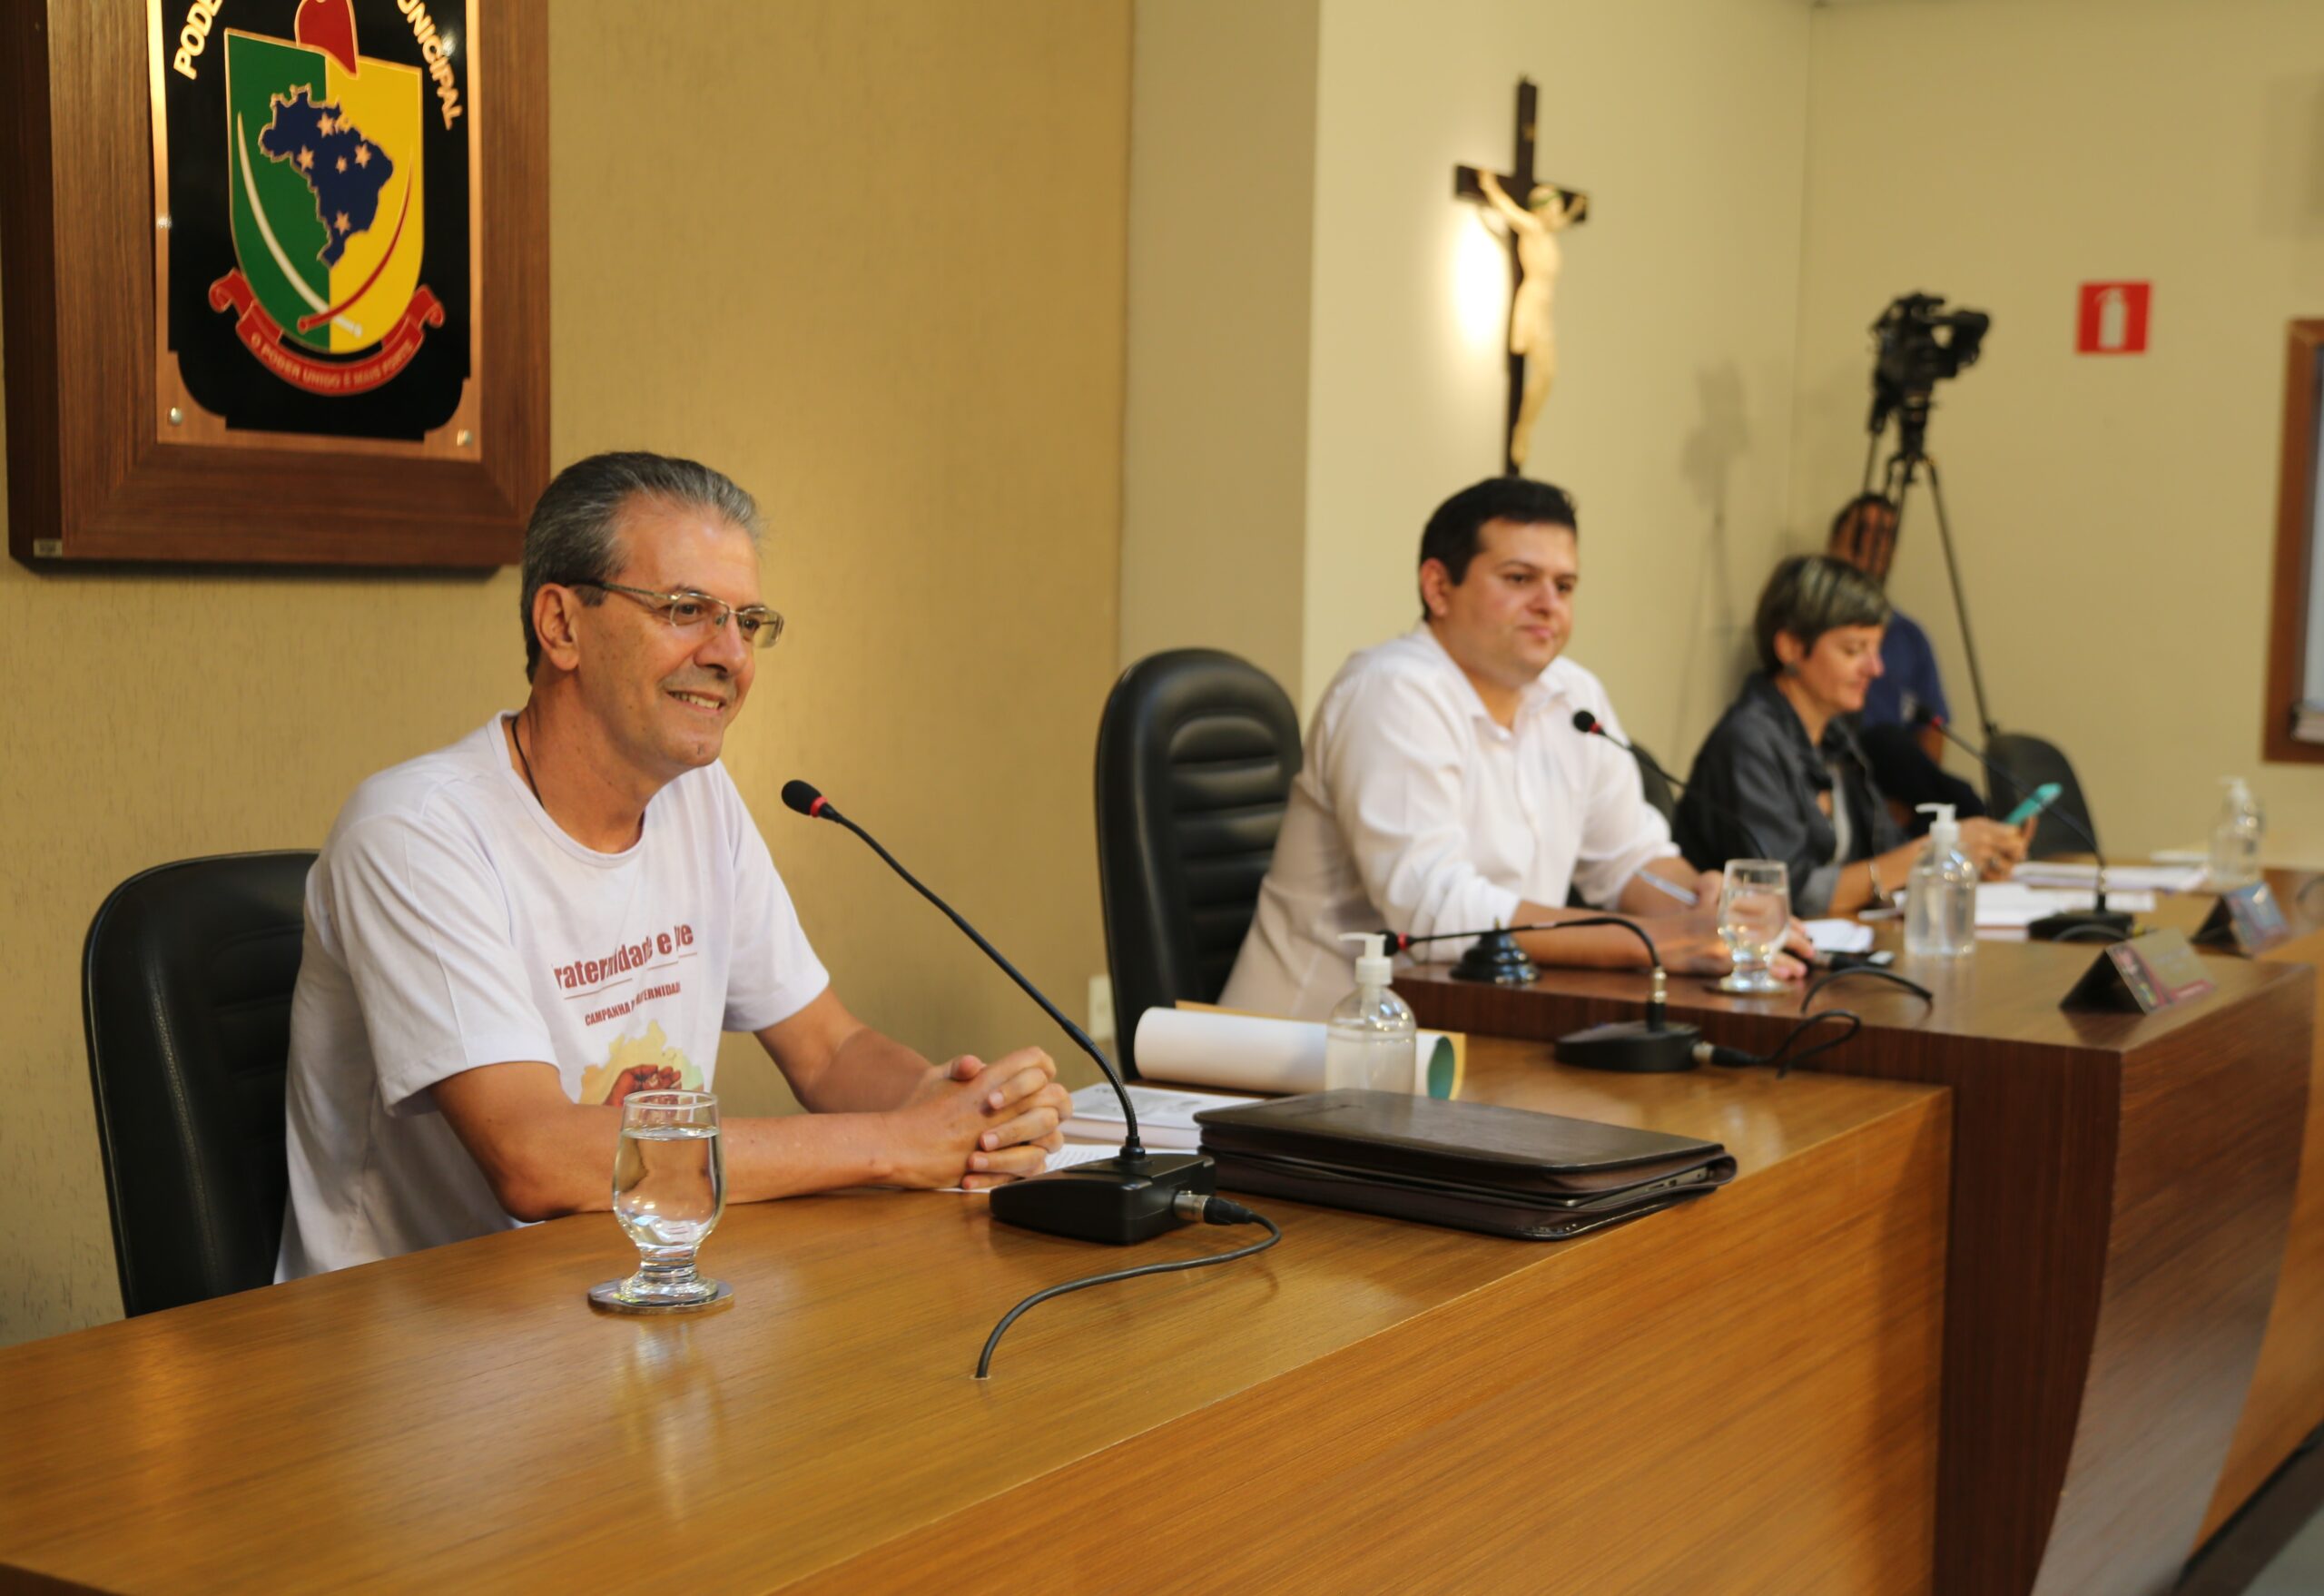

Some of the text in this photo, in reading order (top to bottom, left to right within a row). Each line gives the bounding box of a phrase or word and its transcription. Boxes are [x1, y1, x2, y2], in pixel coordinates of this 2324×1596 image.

[251, 332, 261, 349] O
[261, 342, 300, 380] PODER
[302, 366, 341, 389] UNIDO
[353, 364, 381, 386] MAIS
[656, 932, 673, 954] e
[585, 1001, 631, 1026] CAMPANHA
